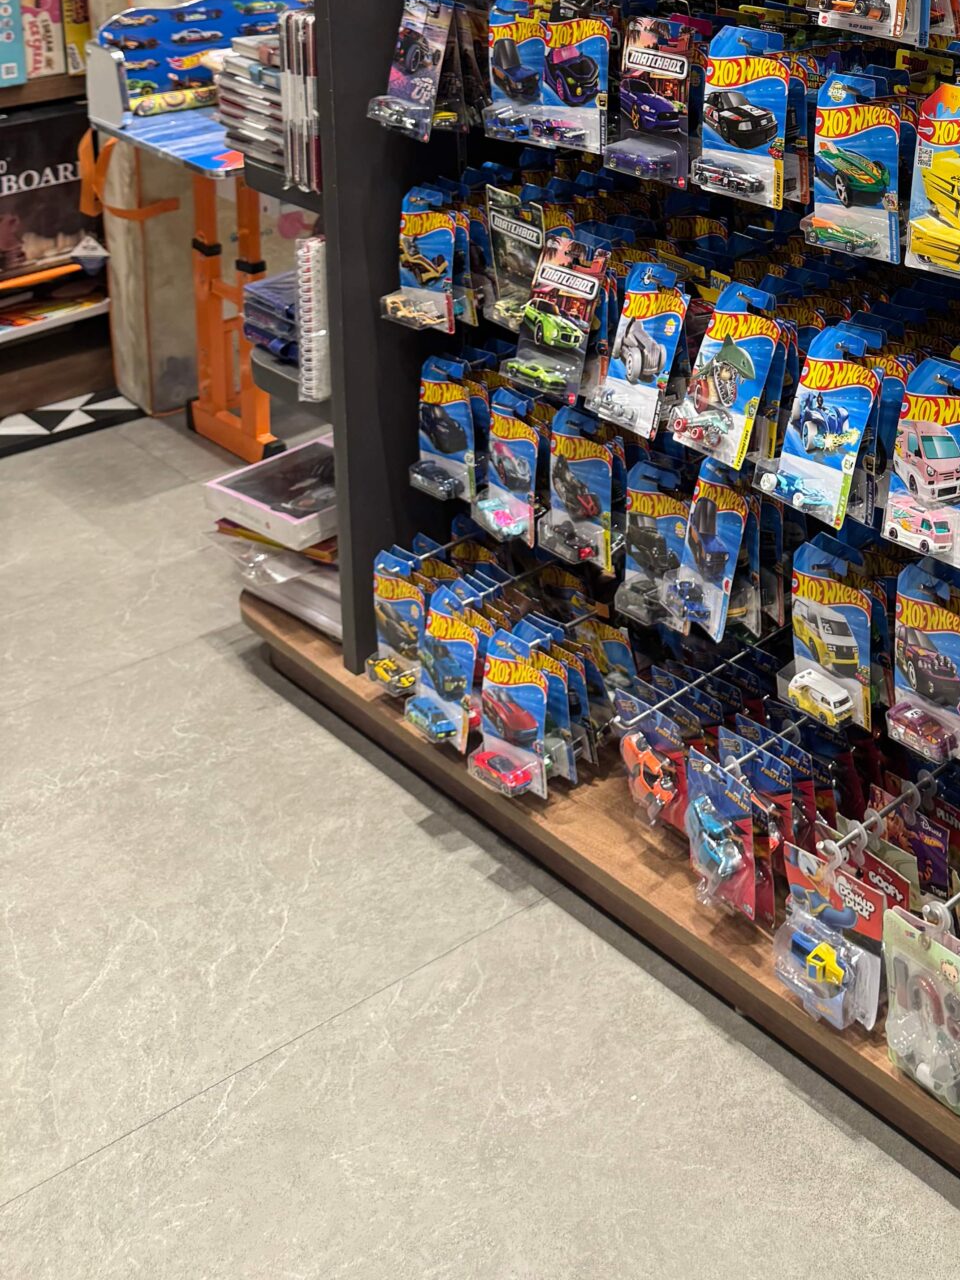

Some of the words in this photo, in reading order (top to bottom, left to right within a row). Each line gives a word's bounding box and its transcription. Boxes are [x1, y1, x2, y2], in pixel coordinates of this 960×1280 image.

[629, 51, 683, 73] MATCHBOX
[2, 162, 80, 195] BOAR
[493, 216, 540, 245] MATCHBOX
[543, 268, 595, 296] MATCHBOX
[839, 882, 876, 913] DONALD
[869, 871, 904, 902] GOOFY
[845, 897, 871, 920] DUCK
